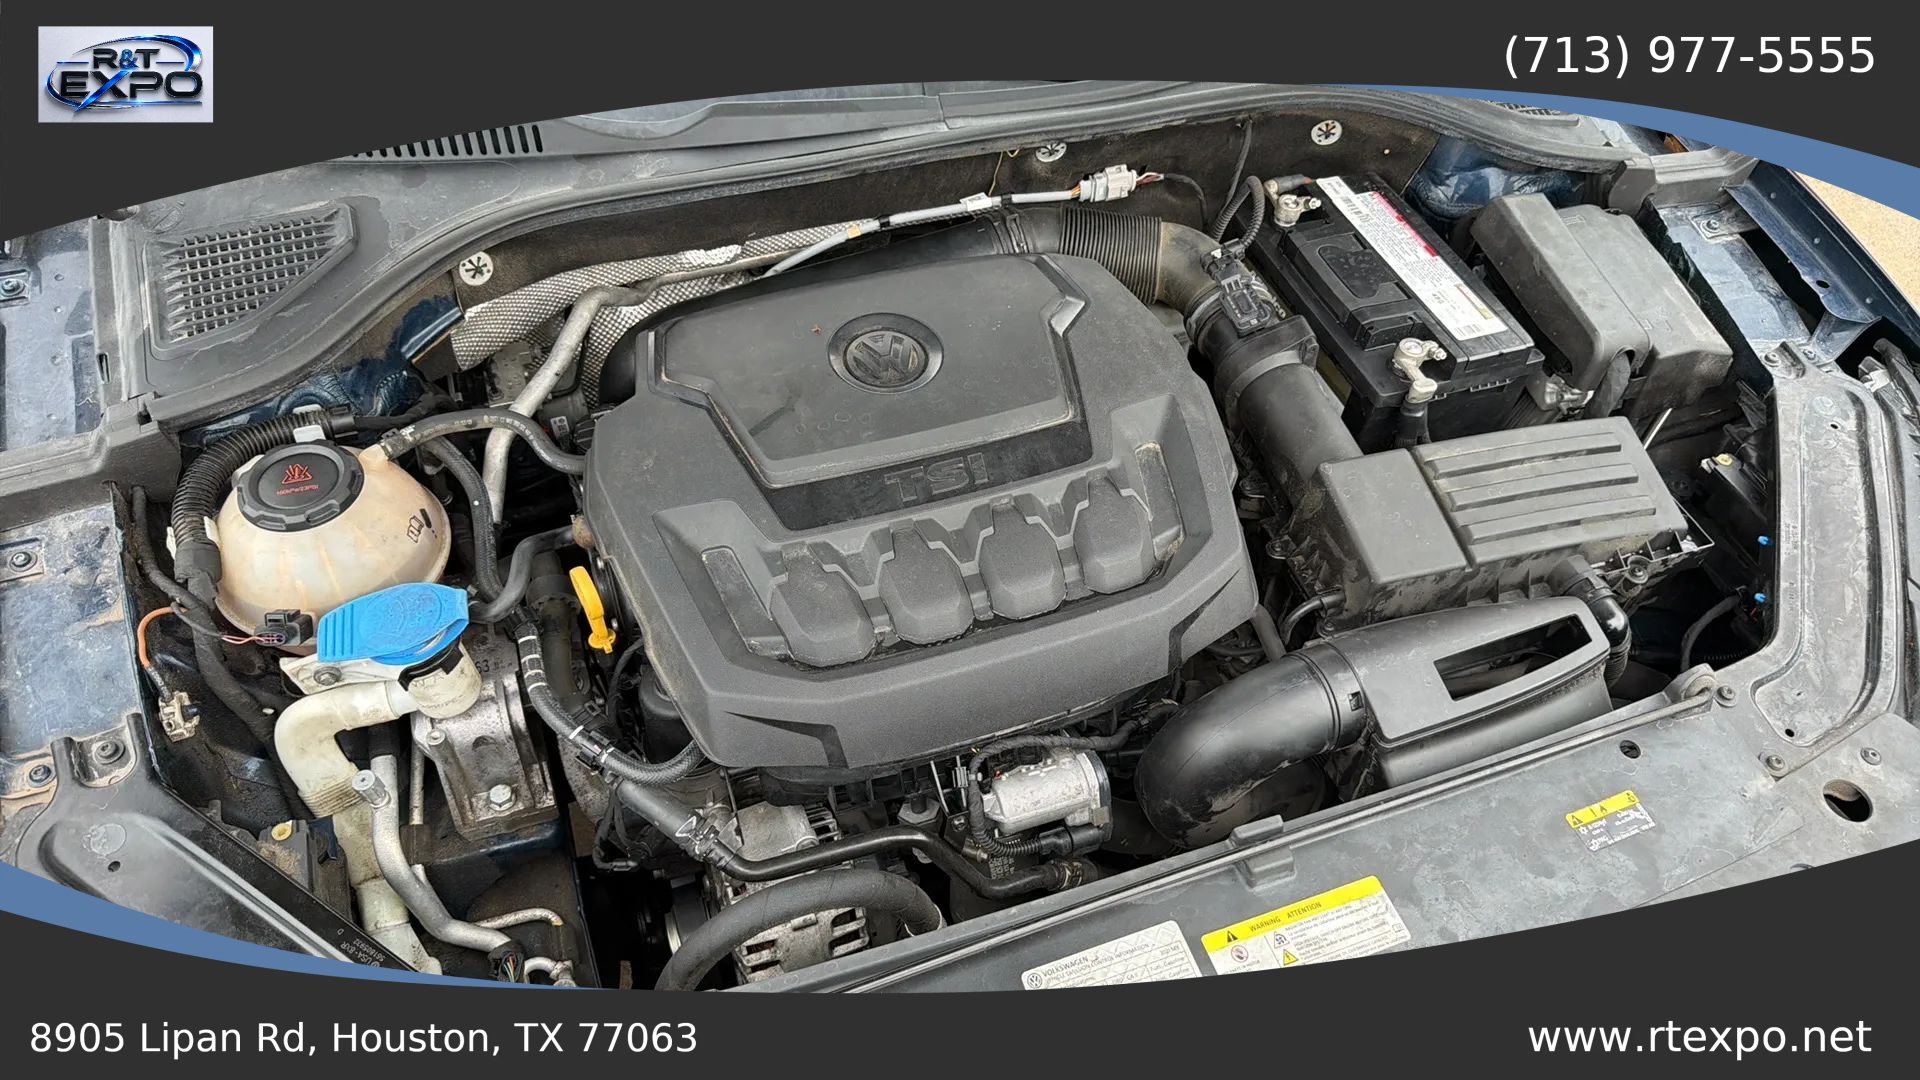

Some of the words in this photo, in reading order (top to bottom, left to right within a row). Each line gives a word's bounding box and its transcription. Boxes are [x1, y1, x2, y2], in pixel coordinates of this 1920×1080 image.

[884, 452, 989, 502] TSI
[1249, 917, 1281, 932] WARNING
[1287, 902, 1322, 919] ATTENTION
[1042, 955, 1089, 977] VOLKSWAGEN
